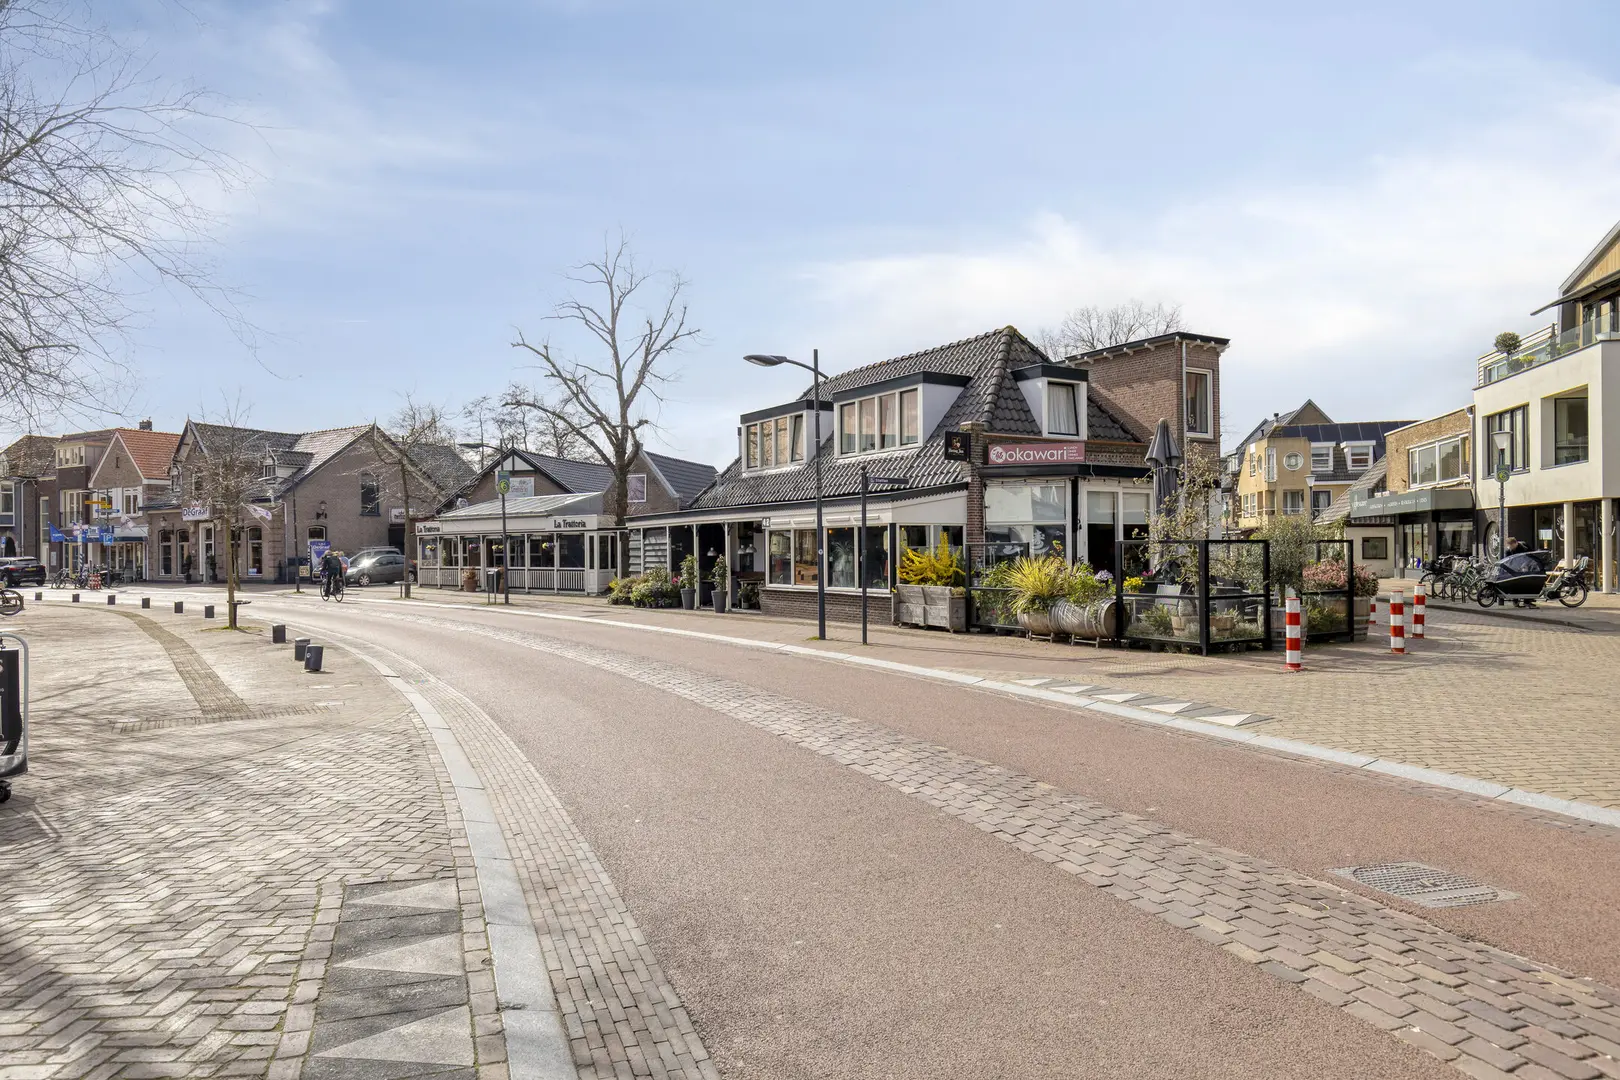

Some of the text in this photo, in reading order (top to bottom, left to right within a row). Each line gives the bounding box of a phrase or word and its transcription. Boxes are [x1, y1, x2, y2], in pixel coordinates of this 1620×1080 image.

[1006, 446, 1067, 461] okawari
[554, 519, 587, 528] La Trattoria
[763, 518, 770, 526] 42
[416, 525, 424, 533] La
